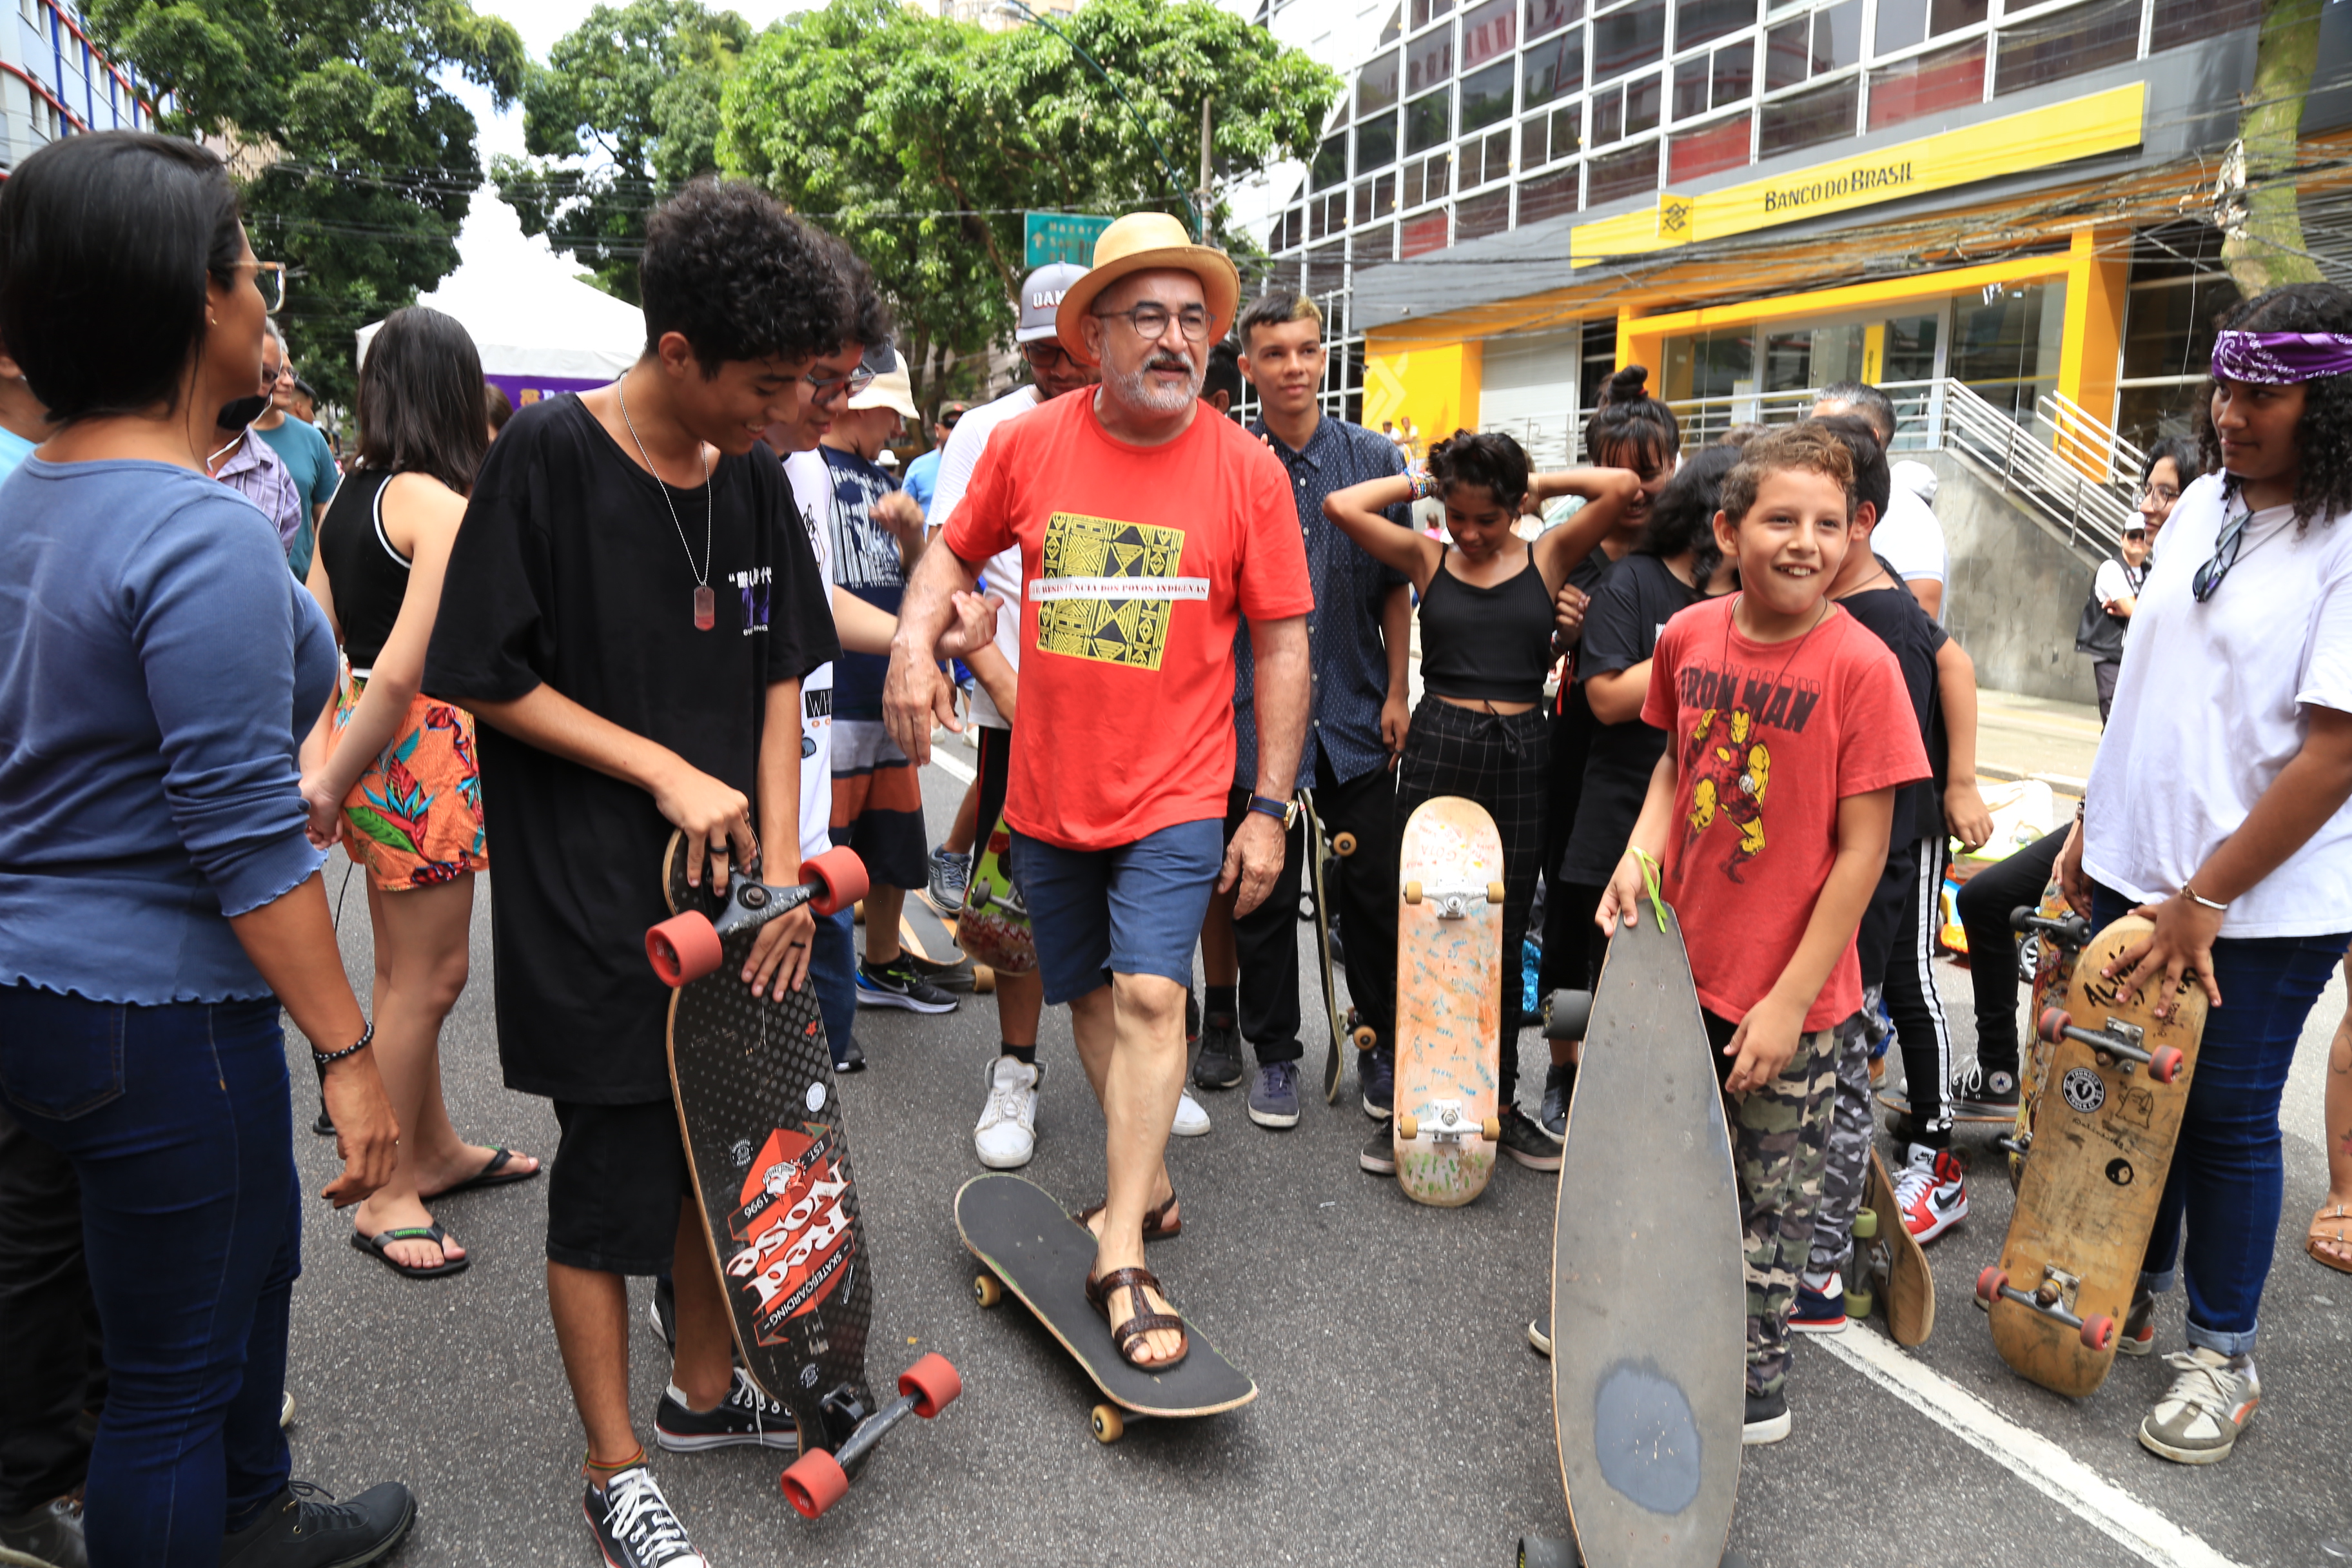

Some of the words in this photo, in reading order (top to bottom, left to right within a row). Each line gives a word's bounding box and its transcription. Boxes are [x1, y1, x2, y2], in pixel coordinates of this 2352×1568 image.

[1765, 183, 1822, 212] BANCO
[1825, 177, 1848, 200] DO
[1852, 161, 1914, 192] BRASIL
[1122, 583, 1153, 593] POVOS
[1679, 662, 1741, 712] IRON
[1742, 672, 1821, 733] MAN
[744, 1193, 769, 1219] 1996
[769, 1250, 843, 1326] SKATEBOARDING
